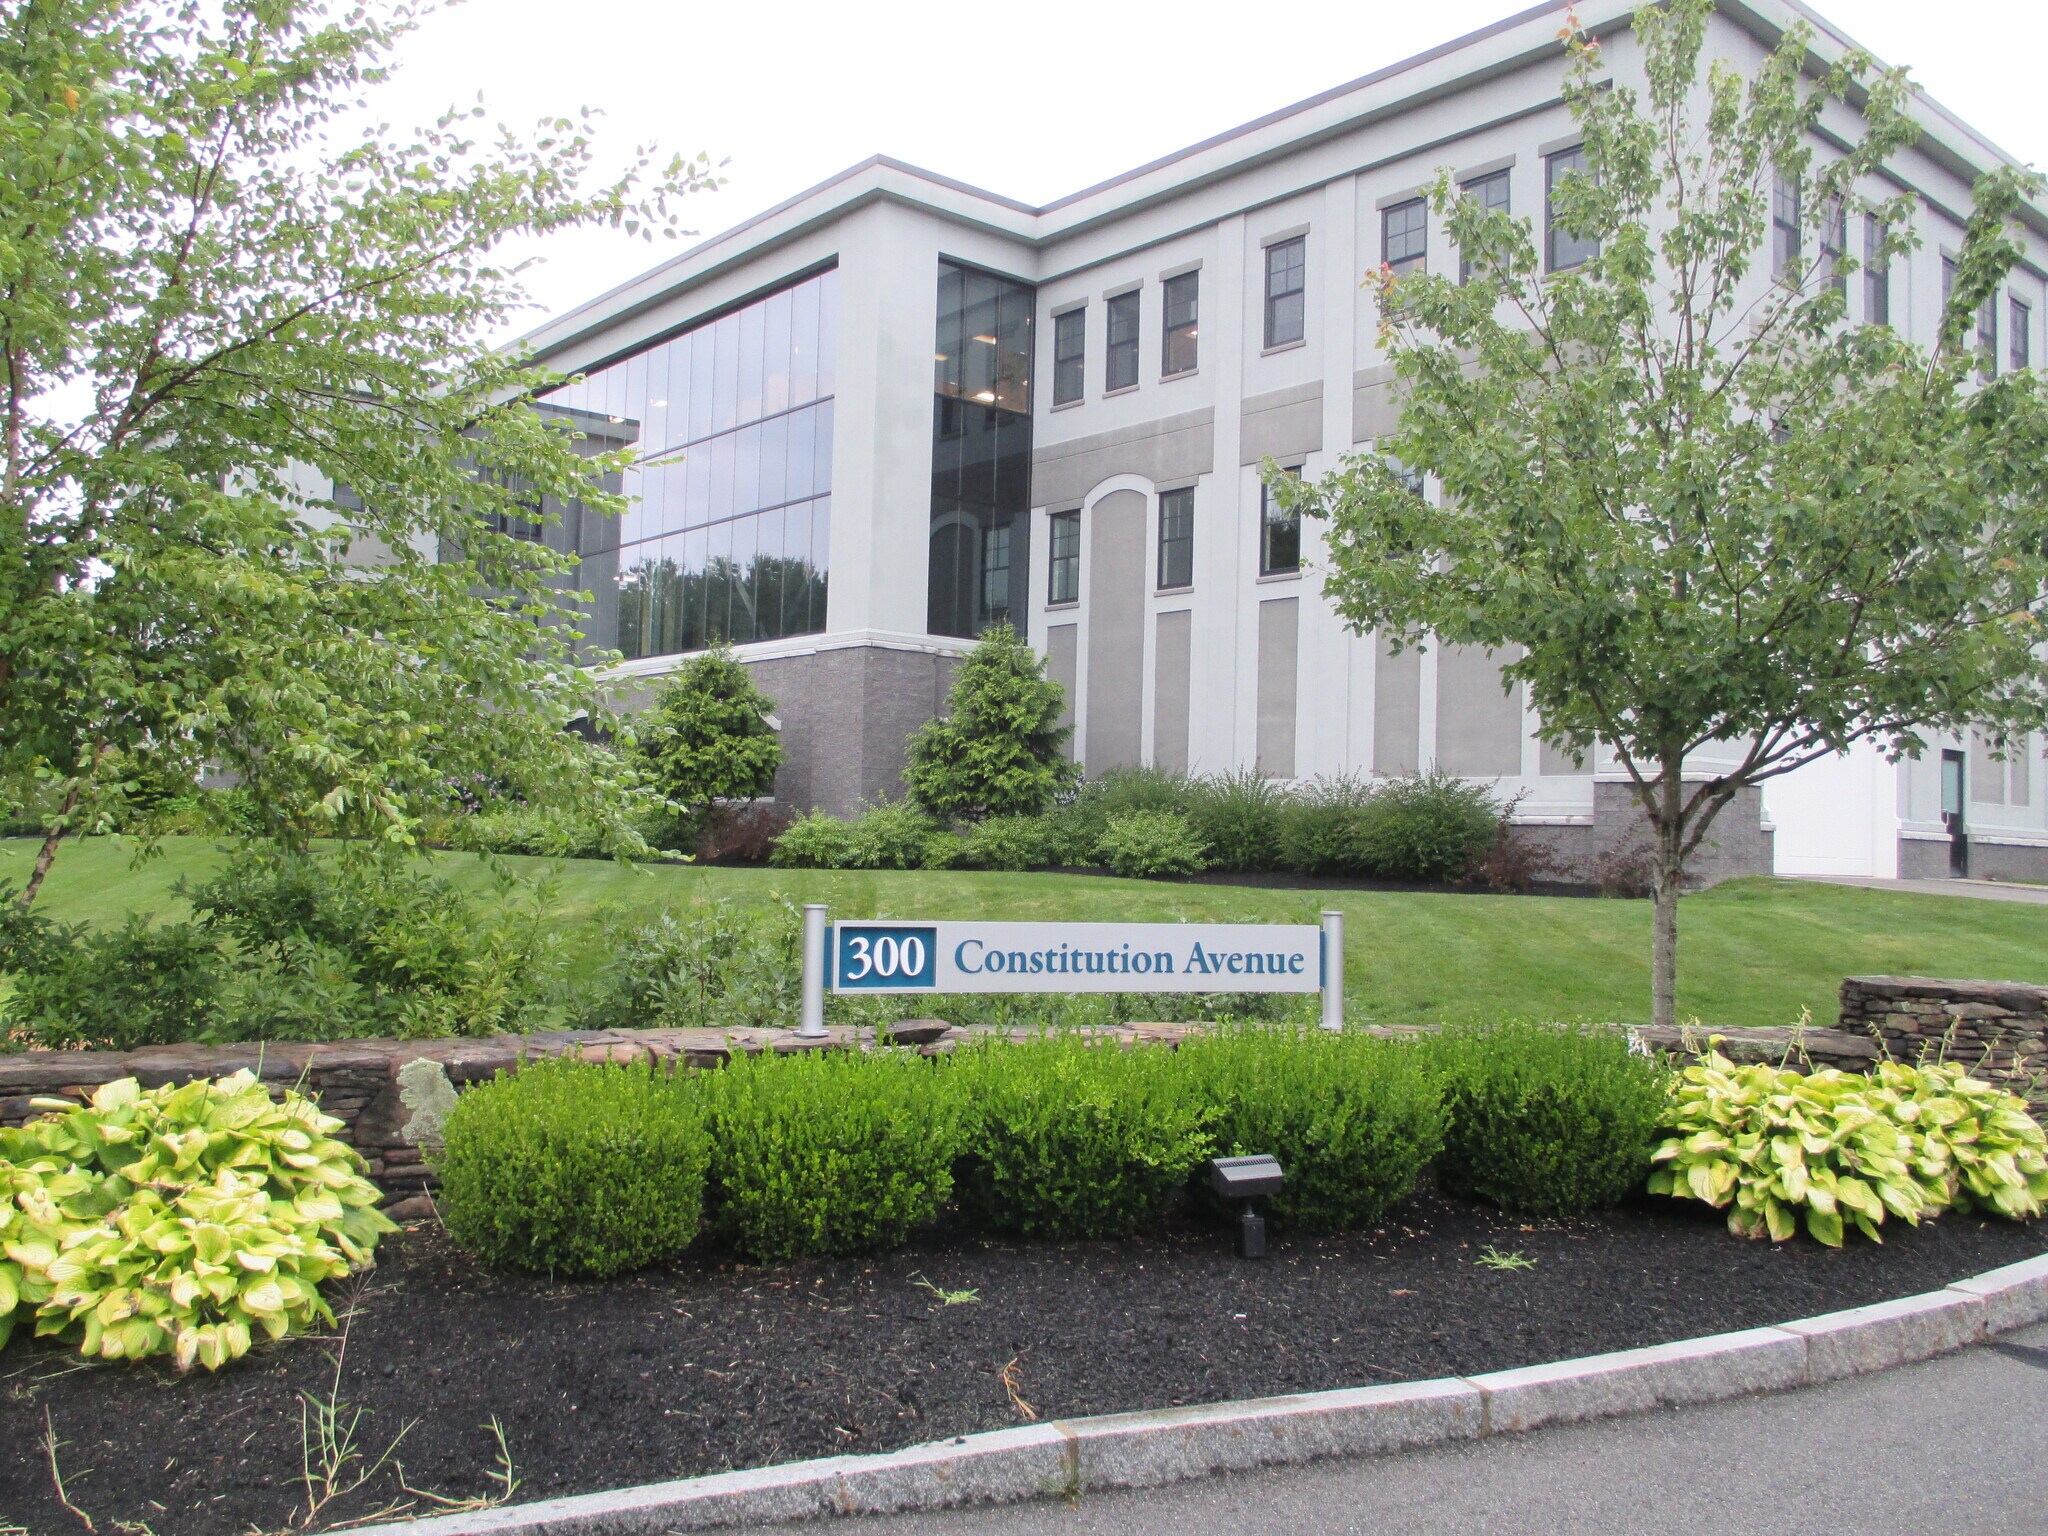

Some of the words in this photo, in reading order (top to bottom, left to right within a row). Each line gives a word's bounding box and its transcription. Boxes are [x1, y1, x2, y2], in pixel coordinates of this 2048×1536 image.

[847, 936, 925, 980] 300
[954, 939, 1174, 974] Constitution
[1182, 941, 1305, 974] Avenue
